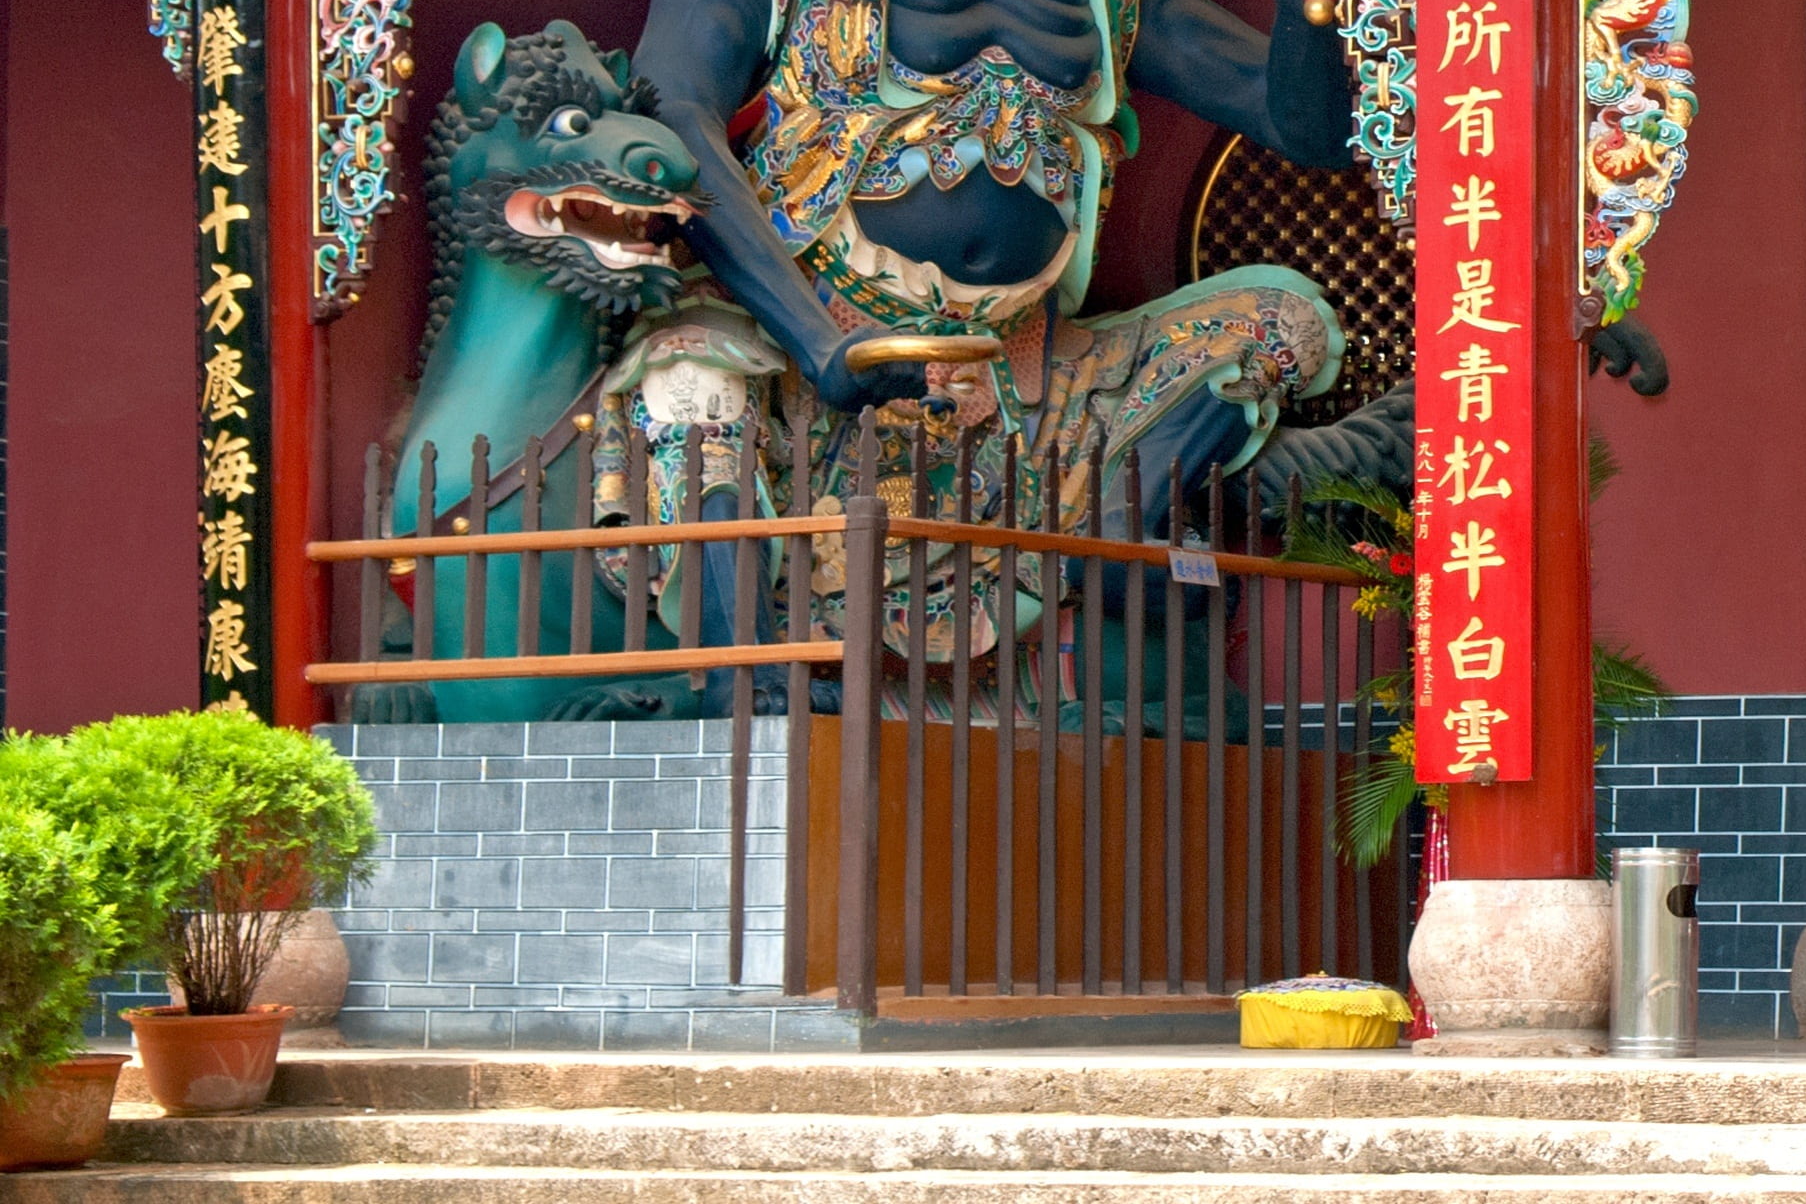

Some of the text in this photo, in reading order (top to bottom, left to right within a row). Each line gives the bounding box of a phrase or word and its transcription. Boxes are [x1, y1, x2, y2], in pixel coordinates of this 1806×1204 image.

[1416, 428, 1435, 539] 一九八一年十月
